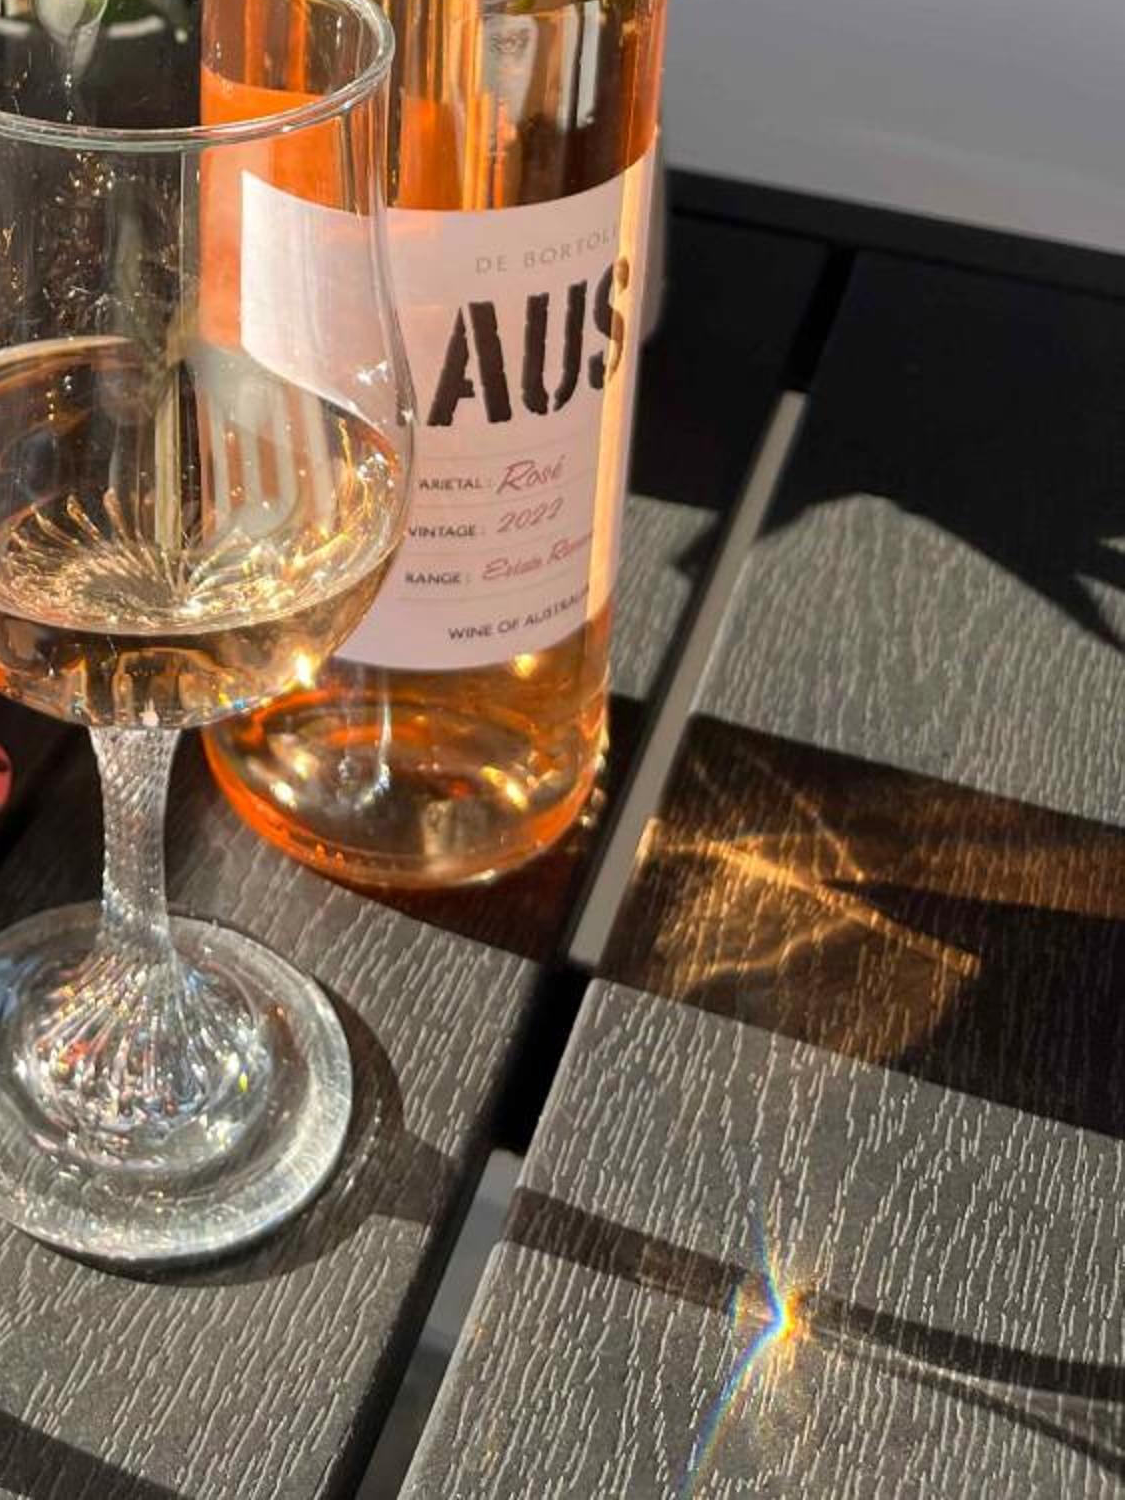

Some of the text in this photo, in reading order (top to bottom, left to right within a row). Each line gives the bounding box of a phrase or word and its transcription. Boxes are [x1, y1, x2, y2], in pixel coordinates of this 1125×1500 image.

[475, 254, 508, 274] DE
[447, 623, 493, 640] WINE
[496, 618, 521, 634] OF
